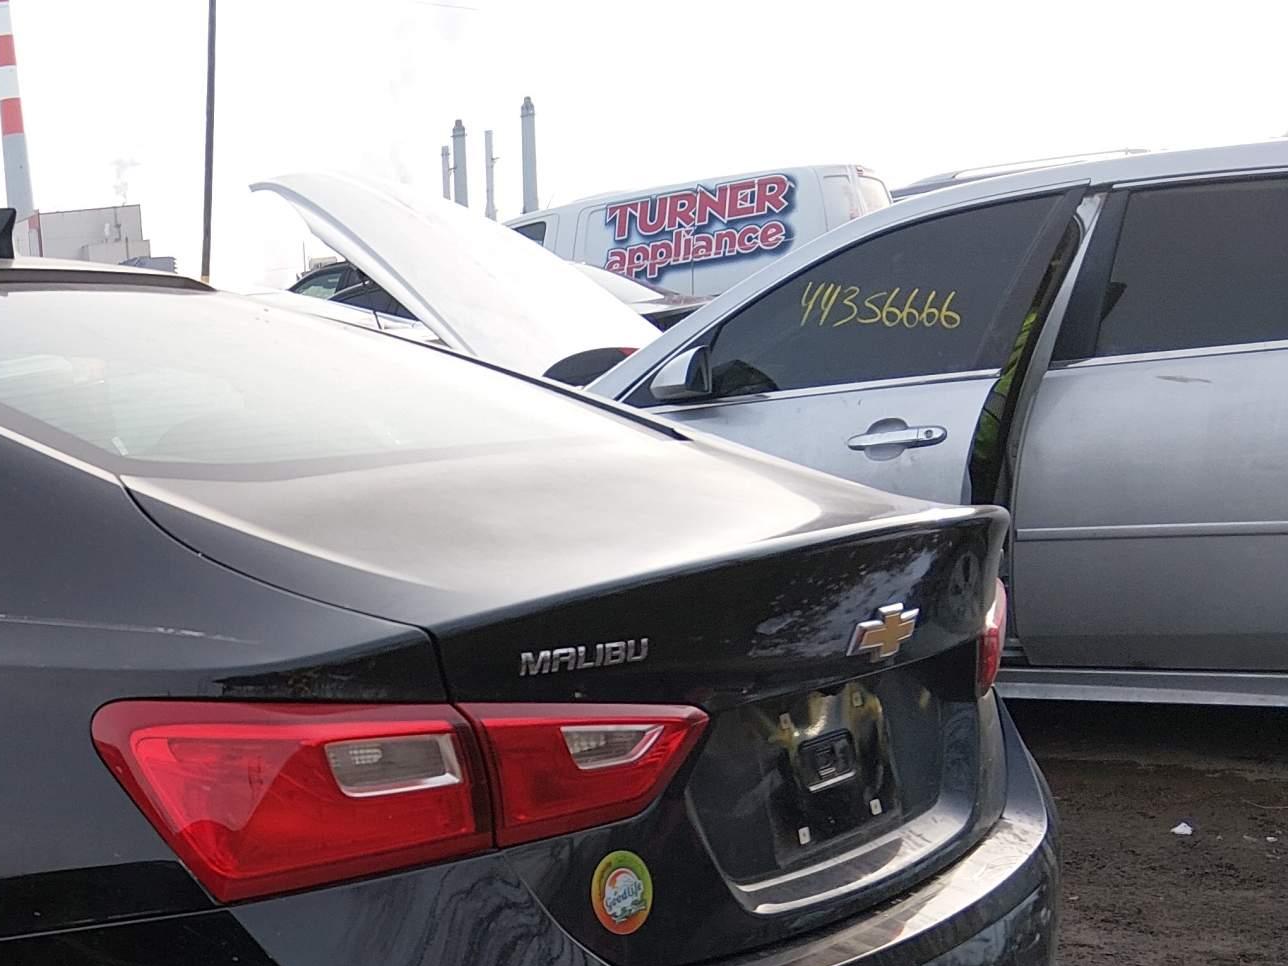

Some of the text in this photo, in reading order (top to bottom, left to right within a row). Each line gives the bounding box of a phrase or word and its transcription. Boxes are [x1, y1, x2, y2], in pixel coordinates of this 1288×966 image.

[606, 175, 792, 240] TURNER
[605, 221, 786, 279] appliance
[800, 281, 961, 329] 44356666
[519, 637, 649, 677] MALIBU
